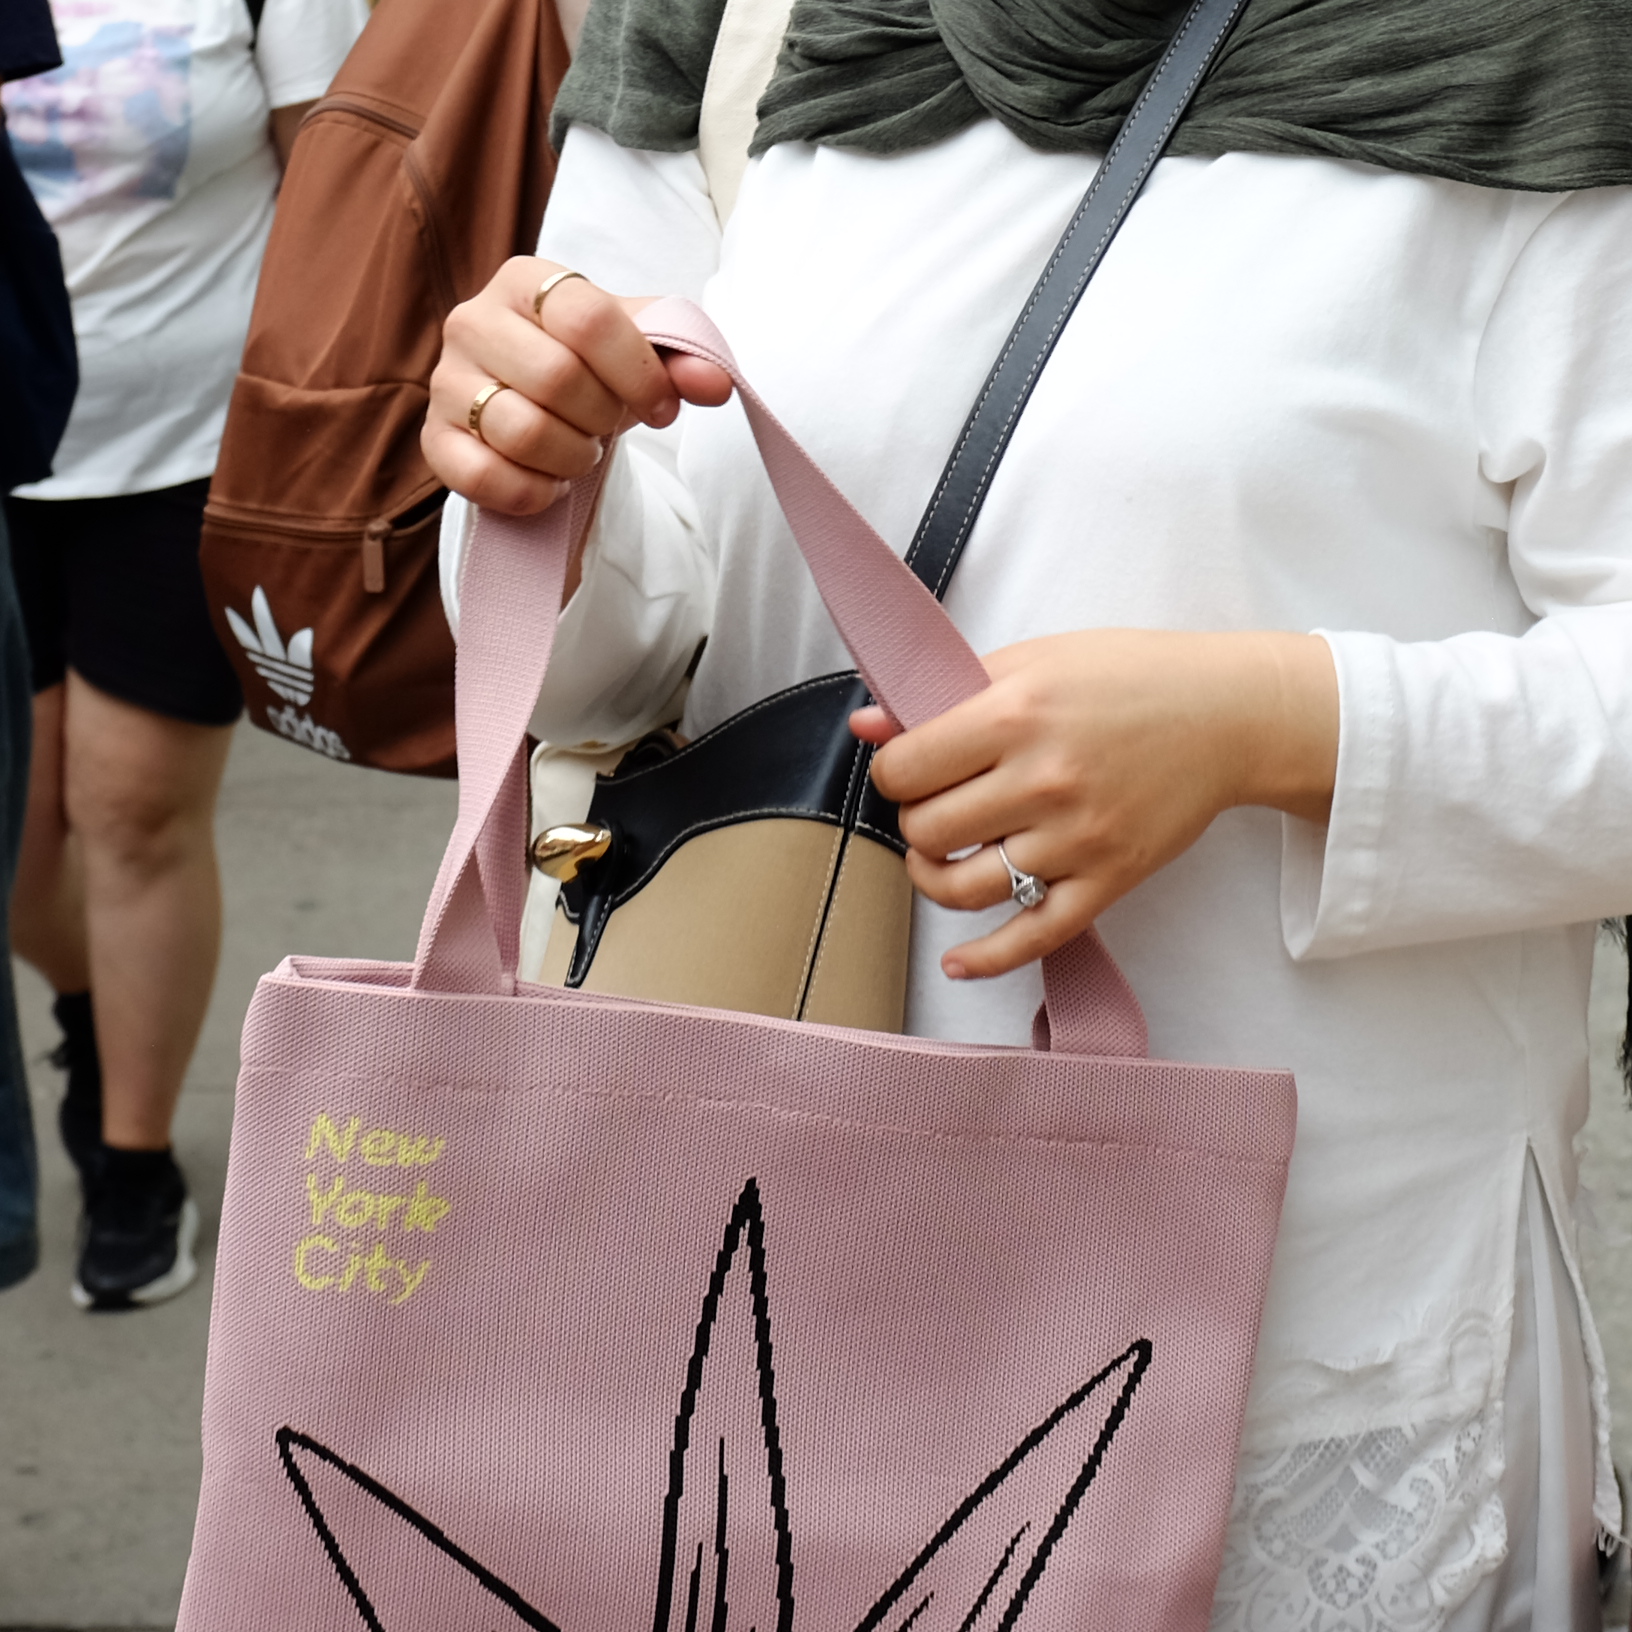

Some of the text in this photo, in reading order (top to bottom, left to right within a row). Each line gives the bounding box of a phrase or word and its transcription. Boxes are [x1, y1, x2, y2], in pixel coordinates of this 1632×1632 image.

[305, 1112, 446, 1168] New
[305, 1172, 452, 1234] York
[294, 1233, 432, 1306] City
